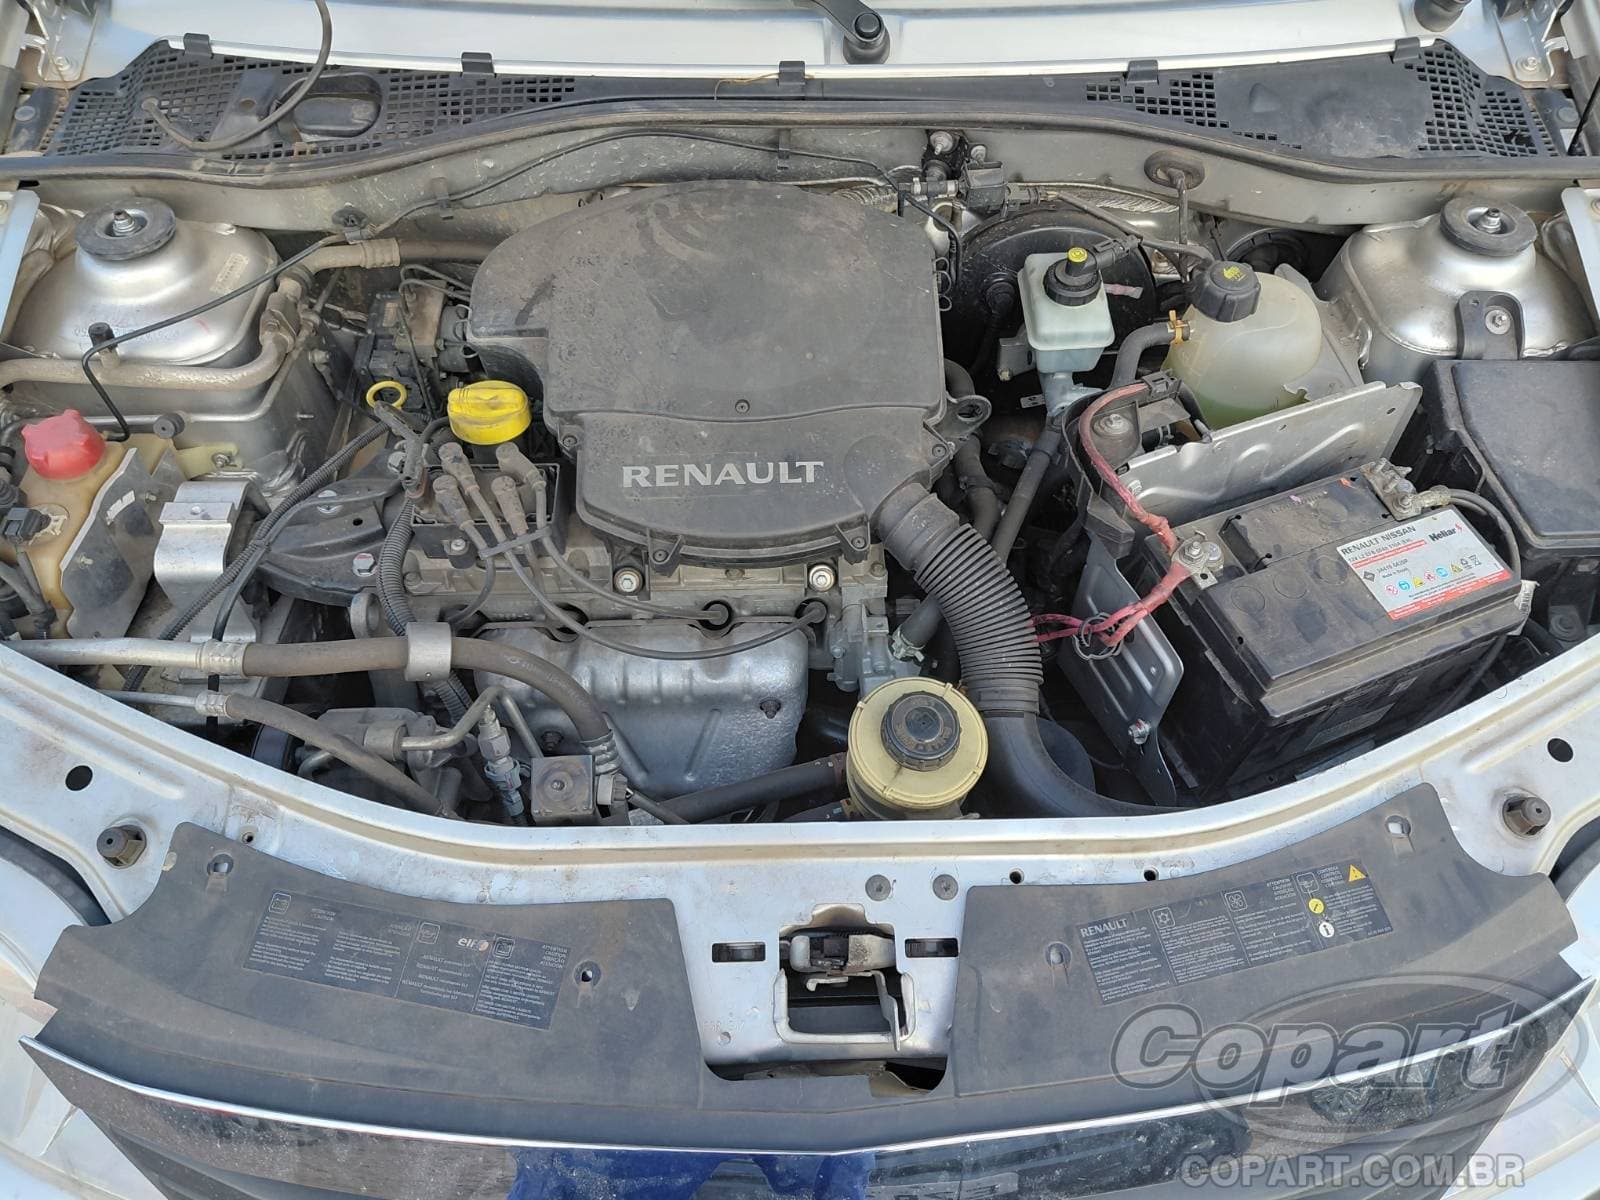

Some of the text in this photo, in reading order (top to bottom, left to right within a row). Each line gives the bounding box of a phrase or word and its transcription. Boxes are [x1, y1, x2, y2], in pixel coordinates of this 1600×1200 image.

[622, 461, 824, 488] RENAULT
[1340, 537, 1380, 555] RENAULT
[1380, 526, 1416, 542] NISSAN
[1428, 527, 1457, 542] Heliar
[1080, 918, 1128, 938] RENAULT
